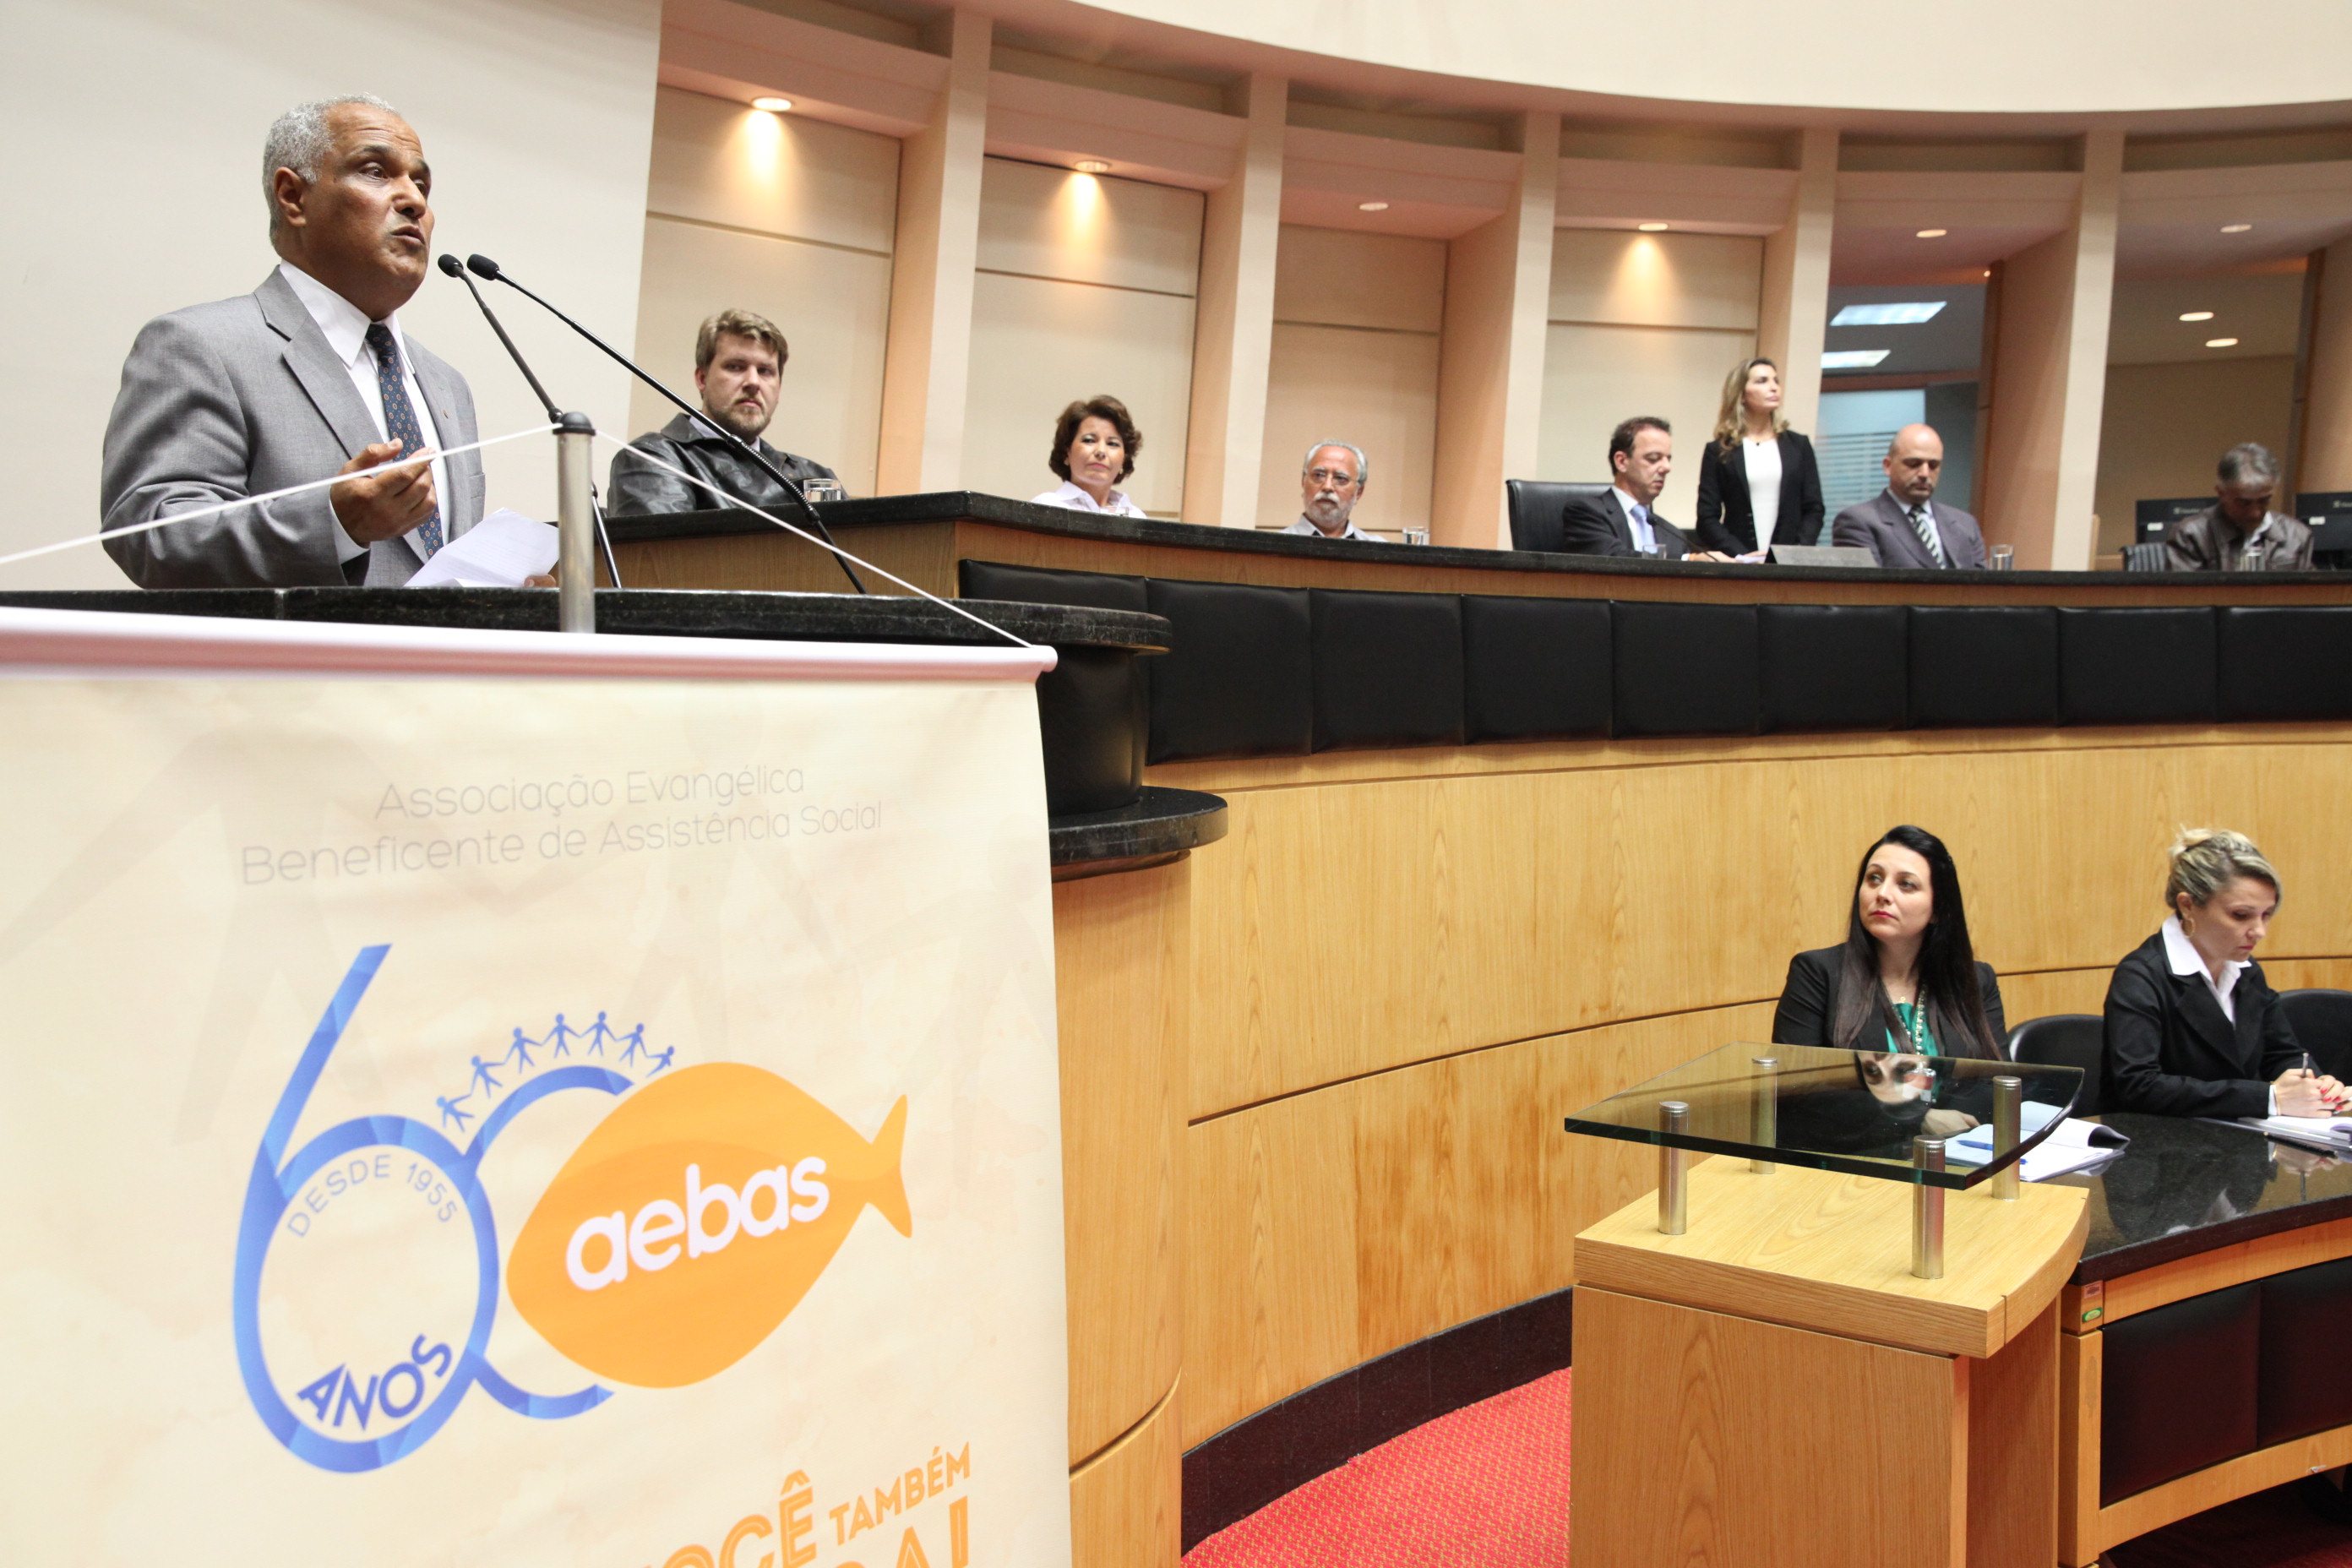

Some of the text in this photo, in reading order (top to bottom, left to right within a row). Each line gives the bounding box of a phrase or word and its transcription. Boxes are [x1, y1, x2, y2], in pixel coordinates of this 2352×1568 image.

[374, 764, 805, 821] Associação Evangélica
[242, 800, 883, 885] Beneficente de Assistência Social
[287, 1154, 458, 1238] DESDE 1955
[565, 1156, 830, 1292] aebas
[296, 1333, 453, 1431] ANOS
[640, 1468, 818, 1568] CÊ
[828, 1440, 971, 1547] TAMBÉM
